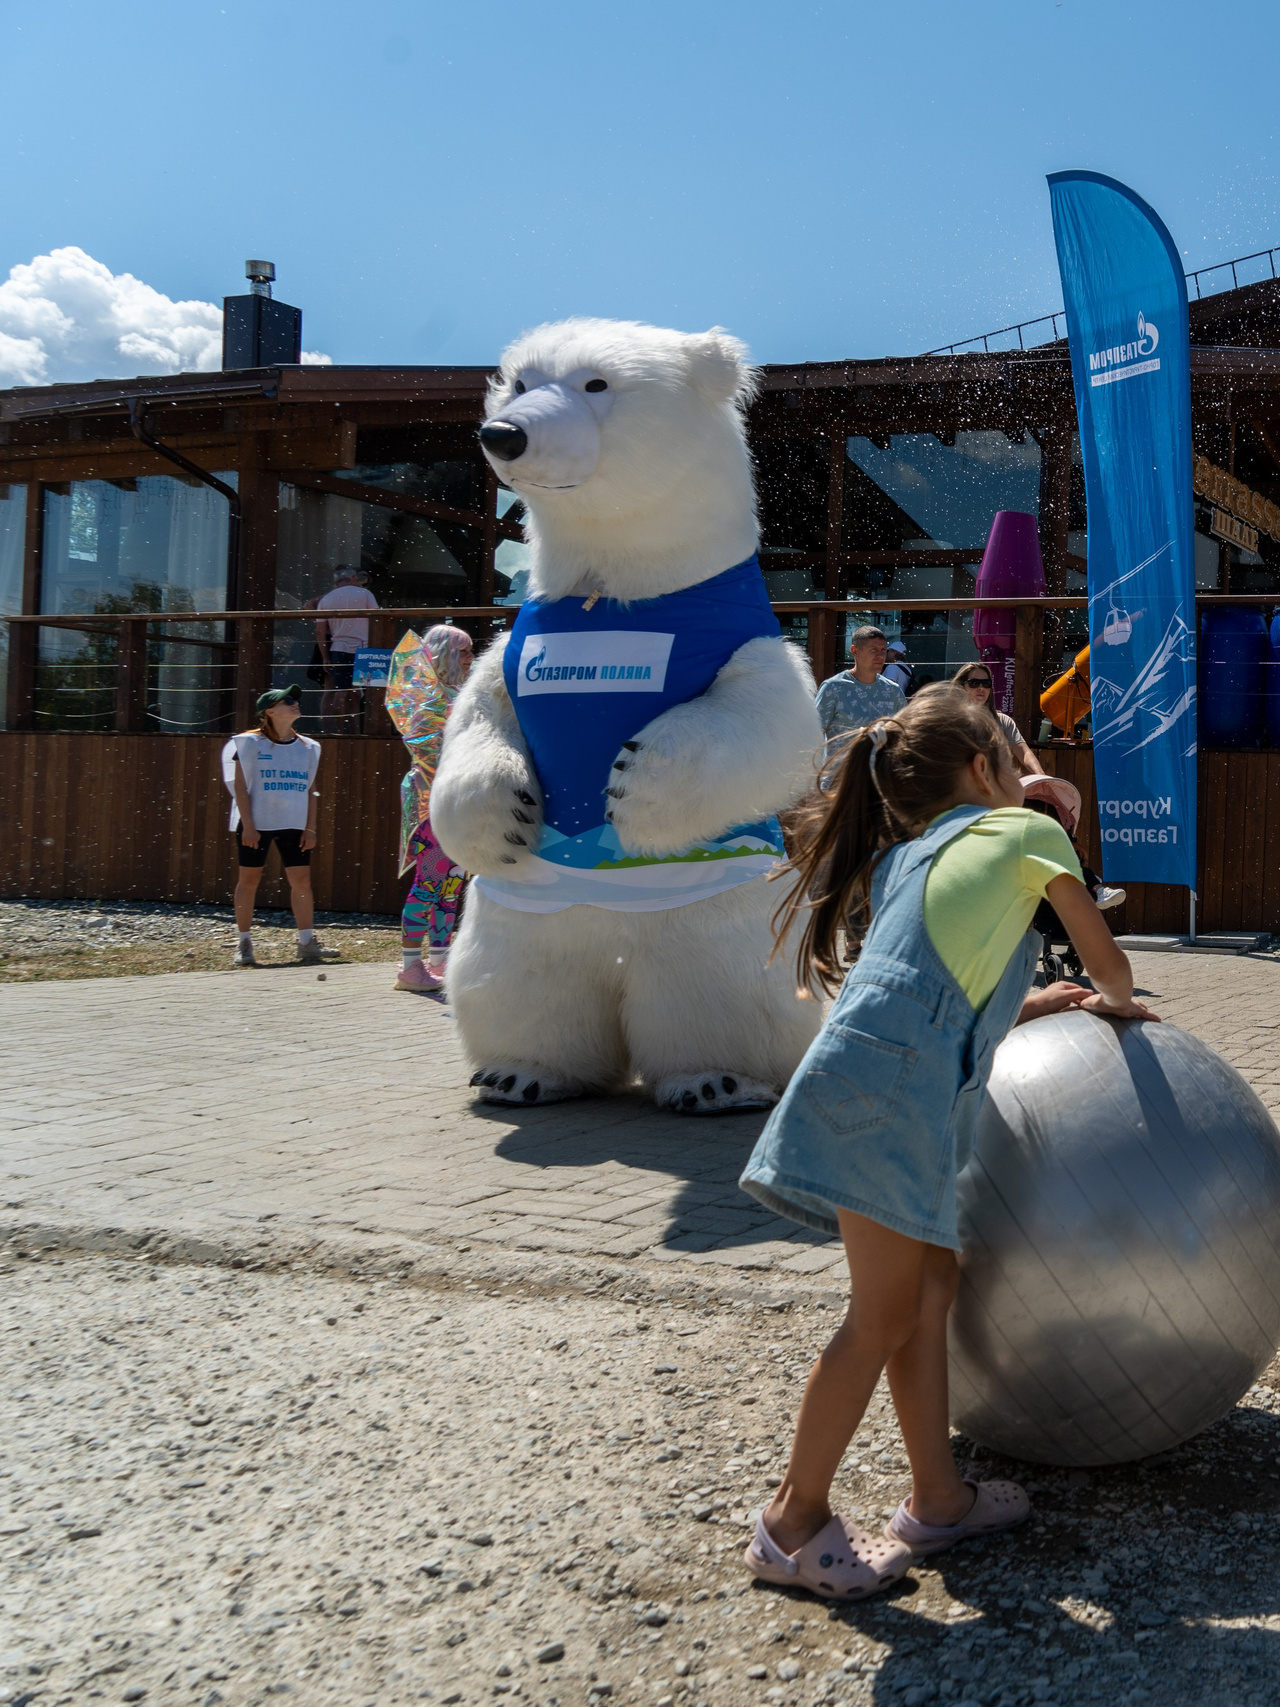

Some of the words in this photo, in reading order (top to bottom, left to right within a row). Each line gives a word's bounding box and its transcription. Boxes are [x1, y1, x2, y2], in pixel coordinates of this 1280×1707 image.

[357, 653, 392, 661] ВИРТУАЛЬН
[368, 661, 387, 669] ЗИМА
[541, 666, 597, 681] ГАЗПРОМ
[600, 665, 651, 680] ПОЛЯНА
[260, 769, 277, 779] ТОТ
[279, 769, 309, 781] САМЫЙ
